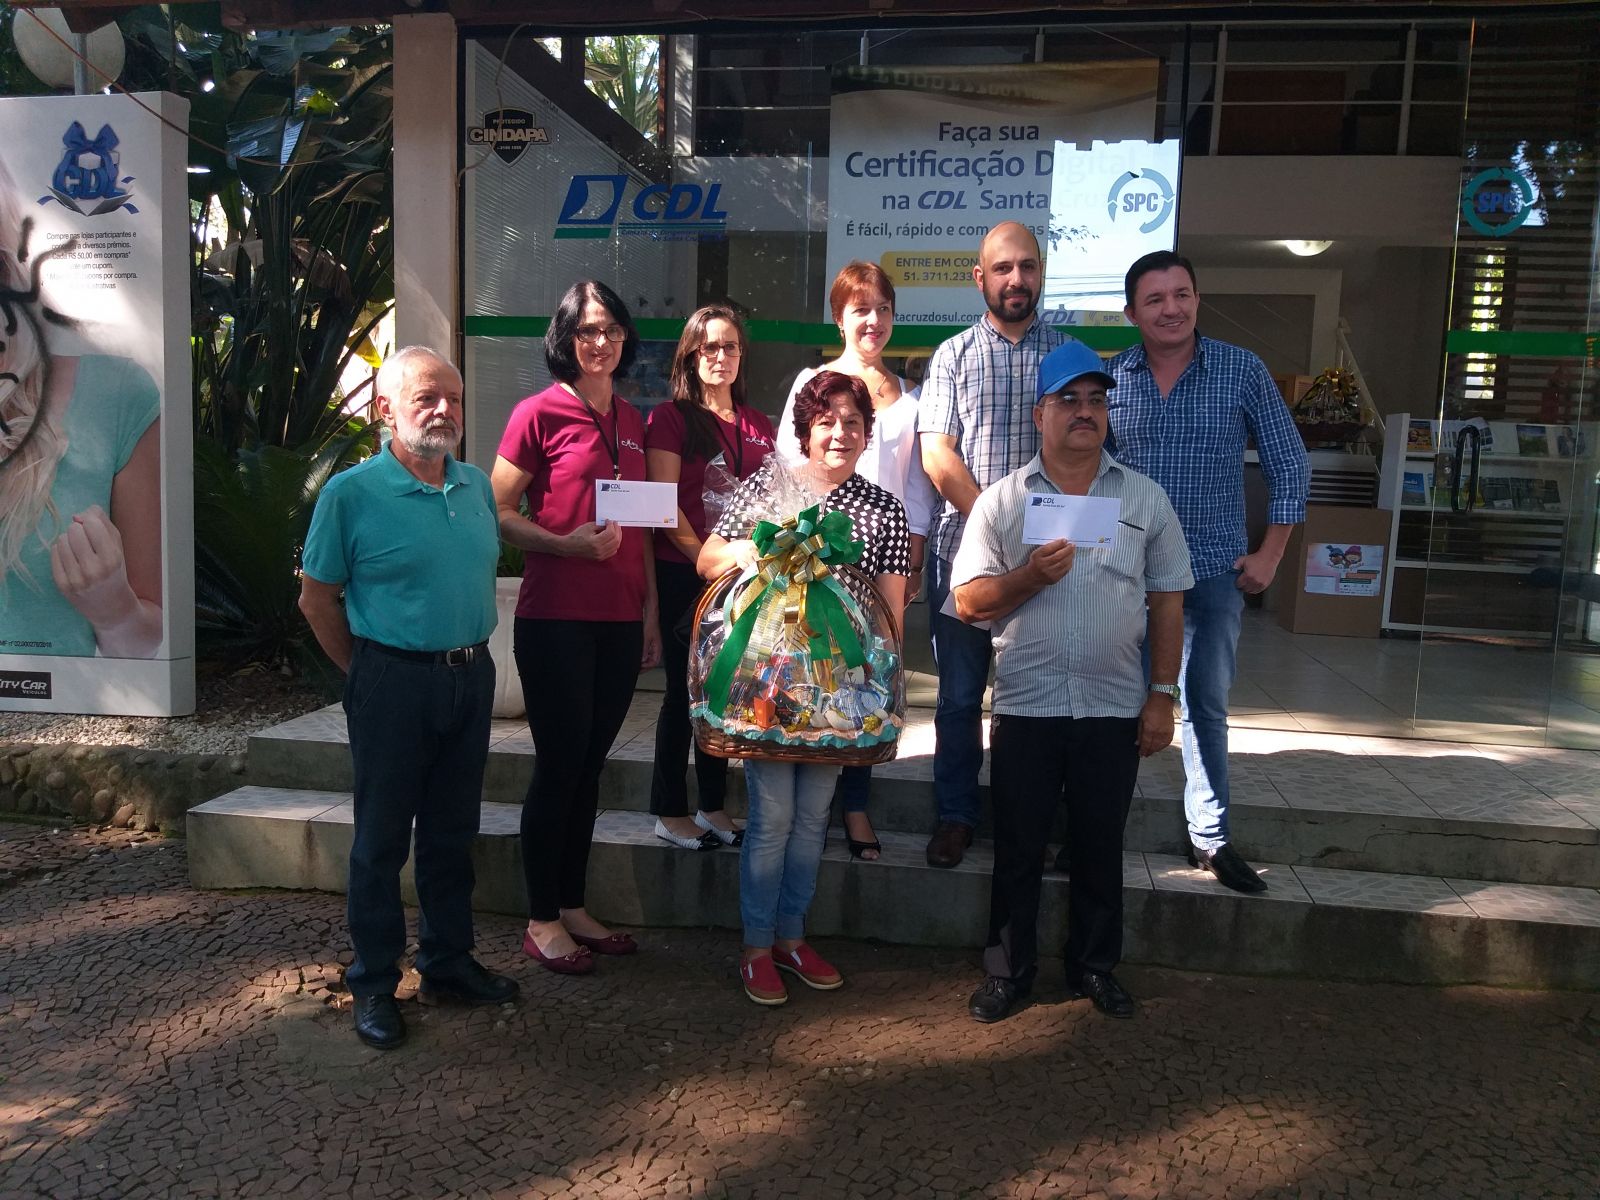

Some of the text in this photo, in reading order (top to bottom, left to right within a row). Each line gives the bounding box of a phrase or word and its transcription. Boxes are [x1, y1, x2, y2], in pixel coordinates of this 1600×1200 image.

[469, 128, 548, 142] CINDAPA
[939, 122, 1040, 147] Faça sua
[845, 150, 1025, 185] Certificação
[633, 184, 728, 220] CDL
[882, 193, 910, 210] na
[917, 190, 968, 210] CDL
[980, 190, 1048, 210] Santa
[1122, 192, 1159, 213] SPC
[1477, 191, 1520, 213] SPC
[46, 233, 69, 241] Compre
[81, 232, 95, 240] lojas
[95, 231, 132, 239] participantes
[846, 221, 855, 236] É
[858, 222, 892, 238] fácil,
[896, 223, 943, 238] rápido
[946, 226, 955, 236] e
[77, 252, 93, 260] 50,00
[896, 258, 978, 267] ENTRE EM CON
[114, 272, 138, 280] compra.
[904, 272, 974, 281] 51. 3711.233
[1039, 310, 1078, 325] CDL
[20, 679, 48, 690] CAR
